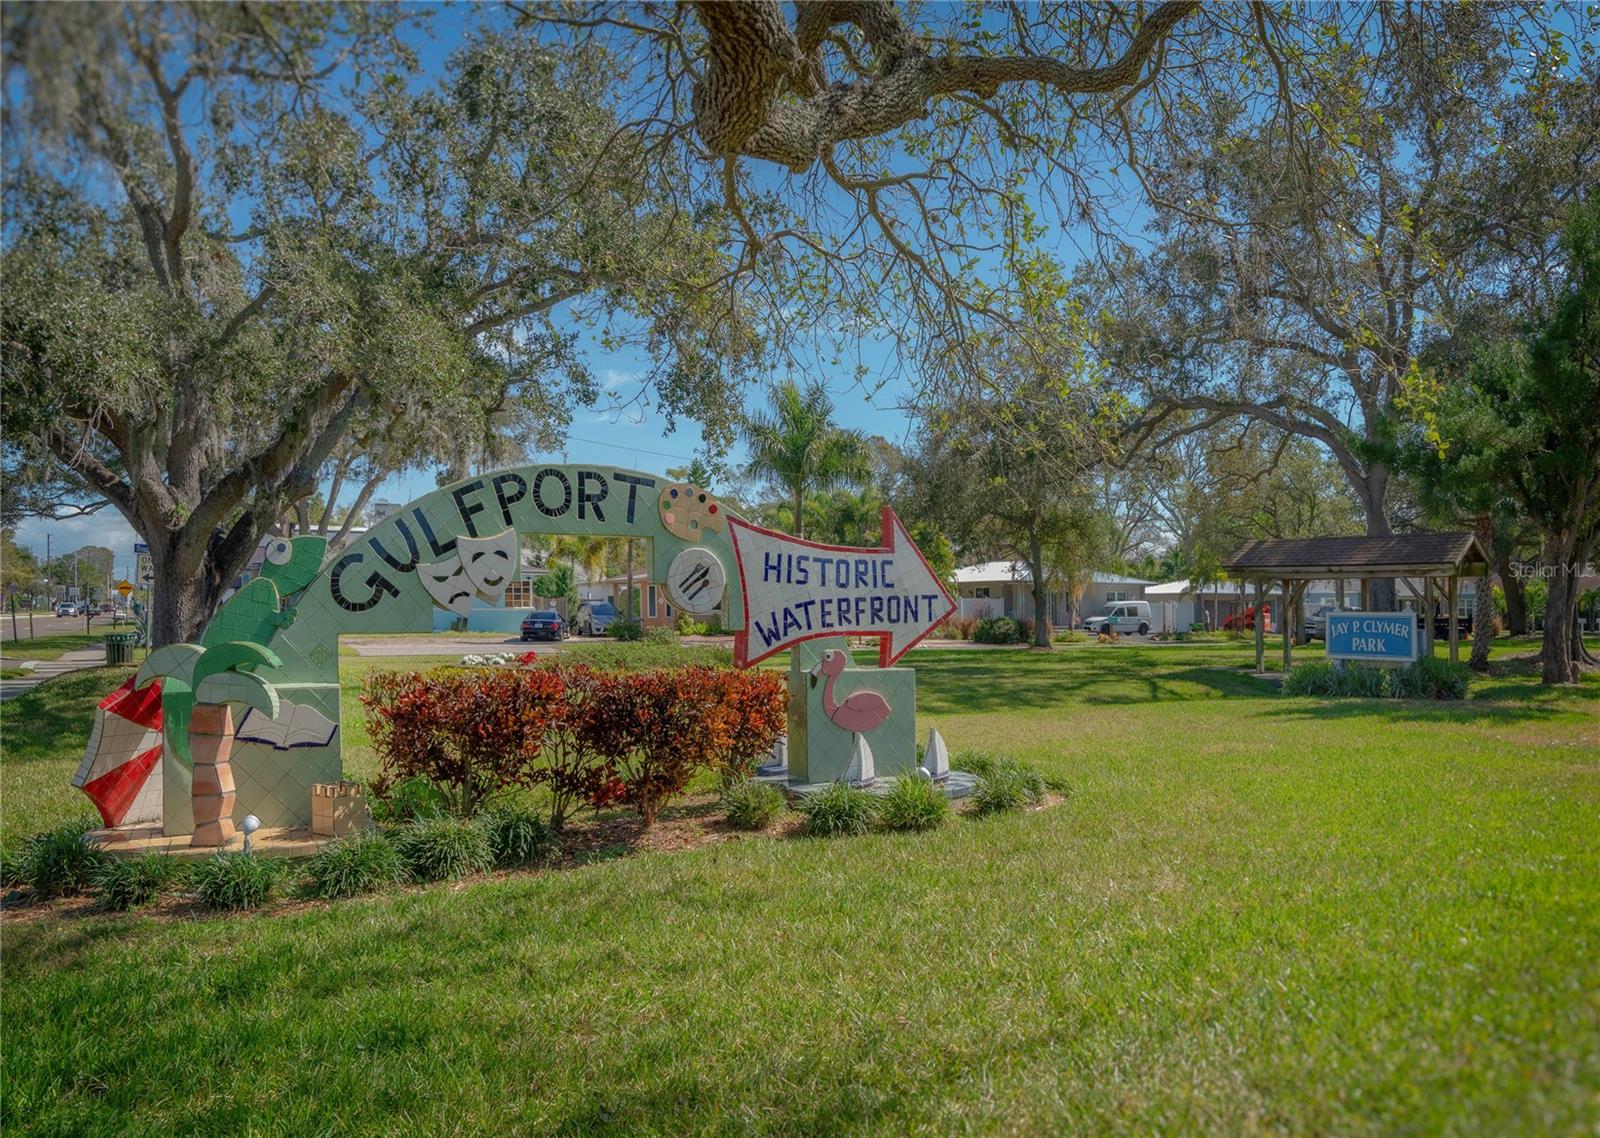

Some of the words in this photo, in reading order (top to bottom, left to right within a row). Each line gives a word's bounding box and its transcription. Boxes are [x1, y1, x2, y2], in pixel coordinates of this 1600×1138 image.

[330, 468, 656, 612] GULFPORT
[763, 552, 895, 589] HISTORIC
[754, 594, 938, 648] WATERFRONT
[1331, 622, 1349, 638] JAY
[1352, 621, 1360, 633] P.
[1363, 620, 1409, 638] CLYMER
[1352, 637, 1386, 652] PARK
